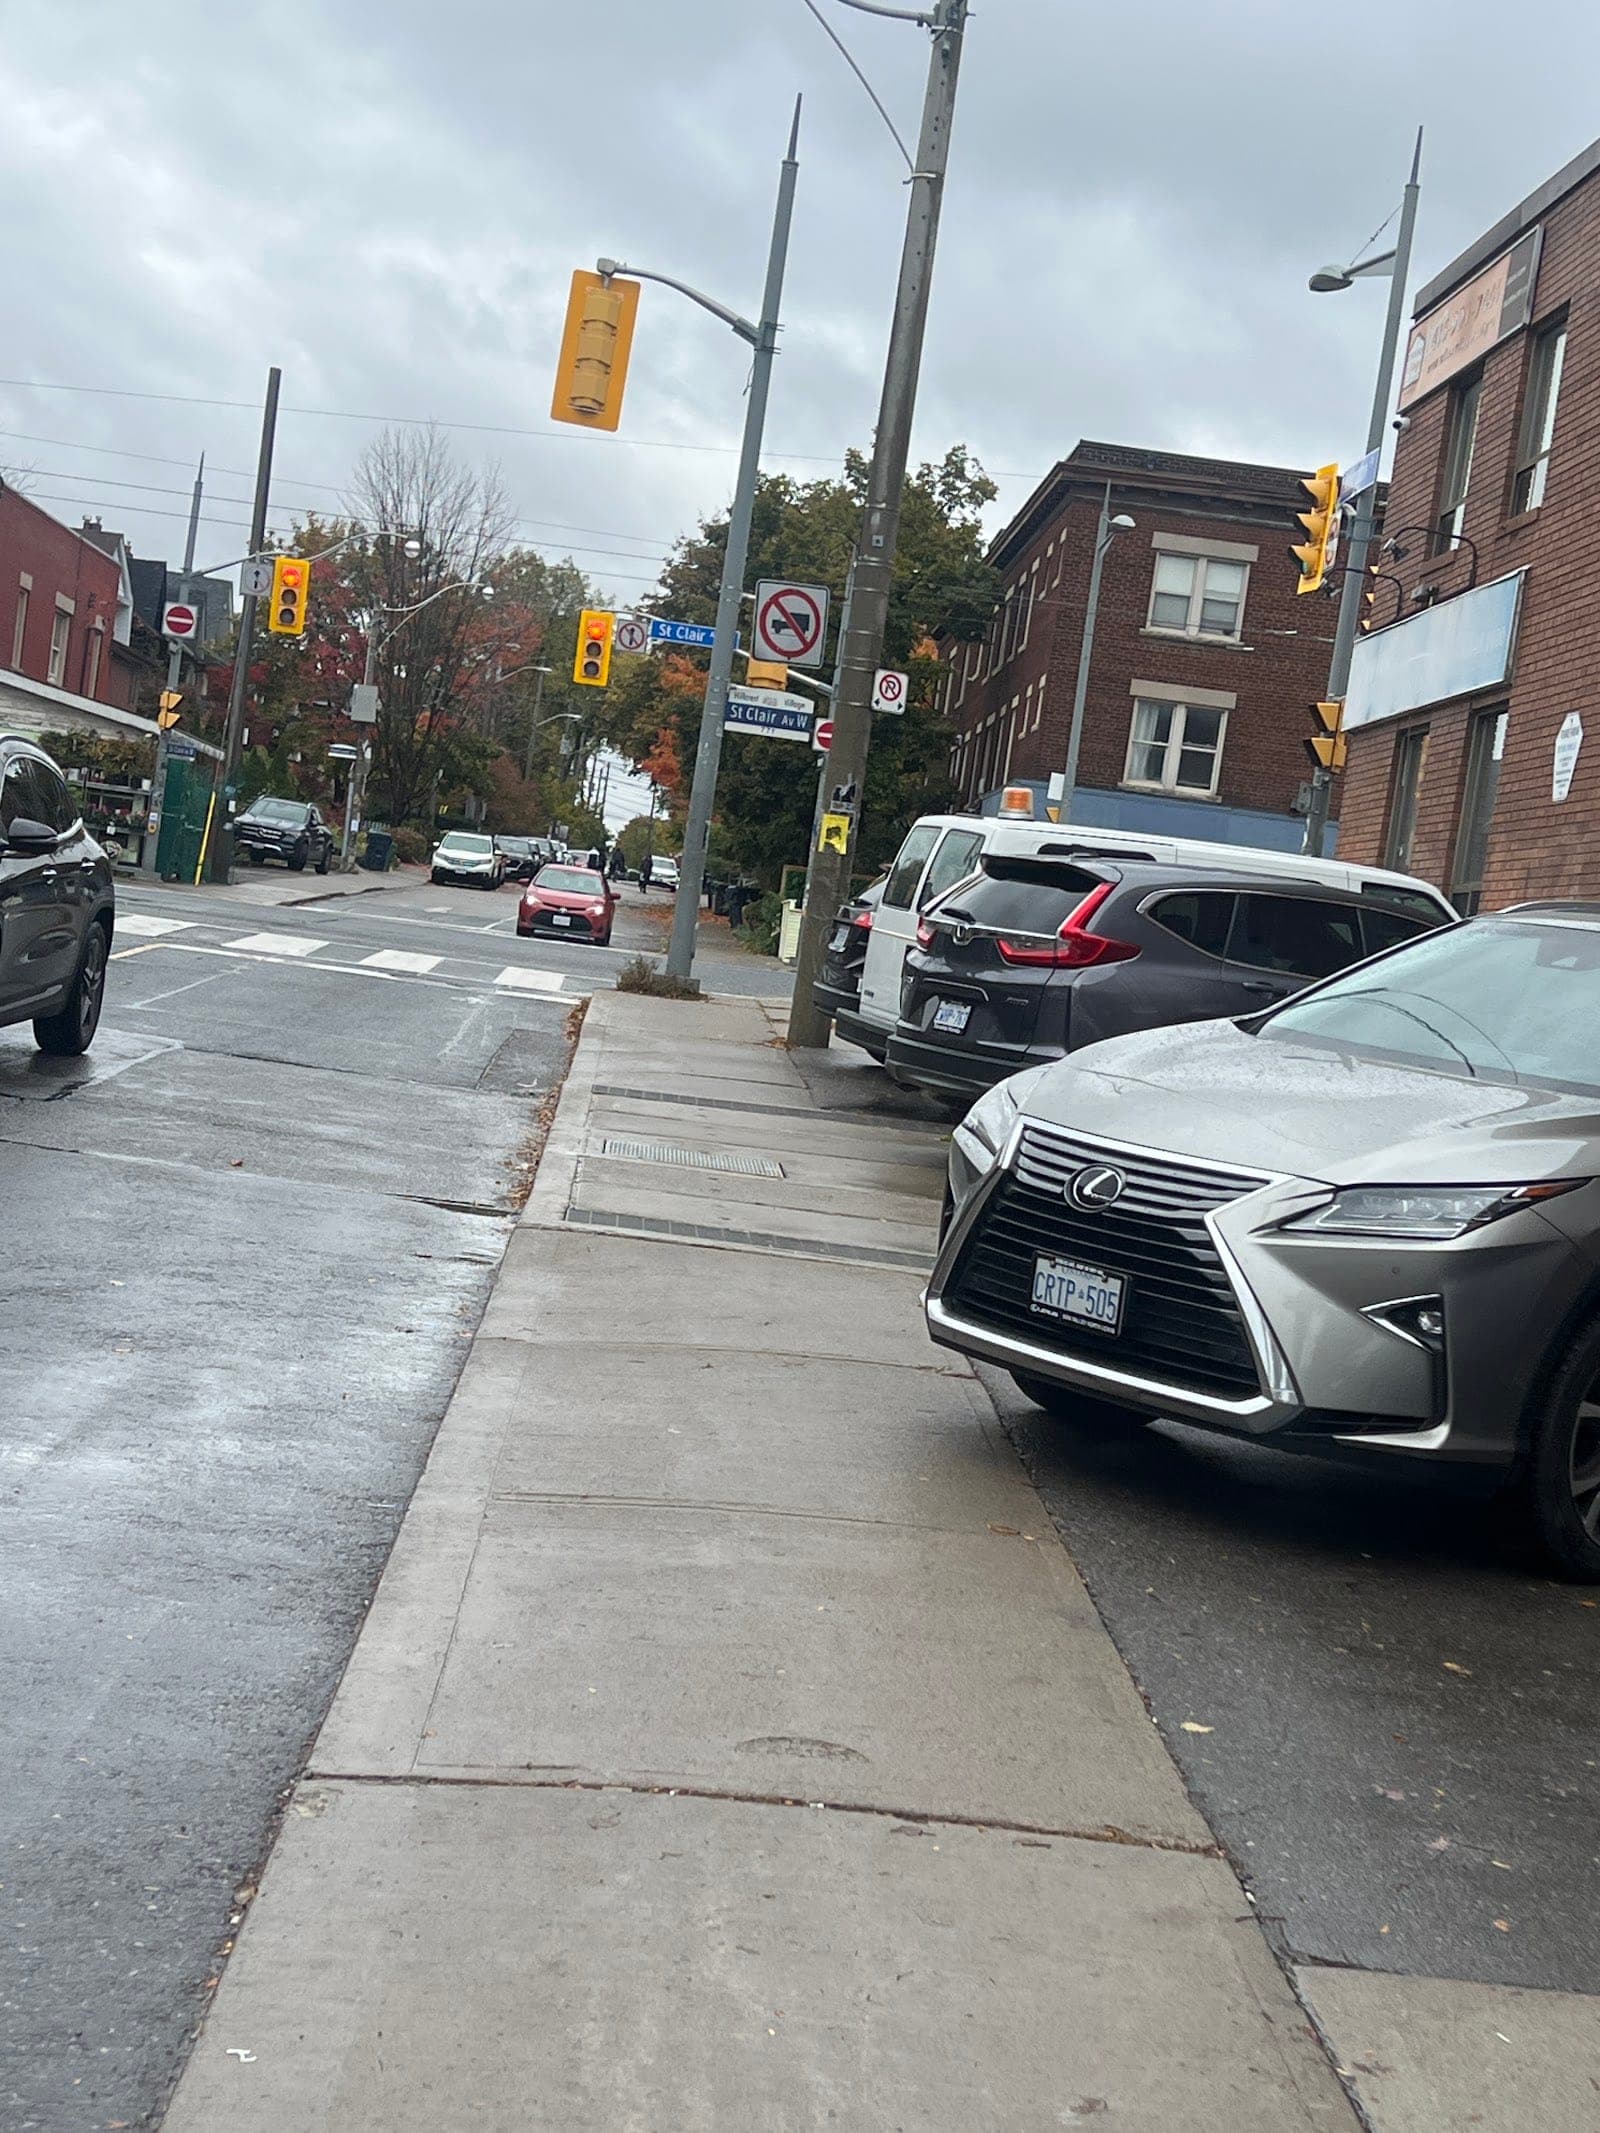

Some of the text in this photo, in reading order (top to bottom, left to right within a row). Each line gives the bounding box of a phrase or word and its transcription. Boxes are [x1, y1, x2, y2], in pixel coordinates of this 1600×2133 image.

[659, 624, 672, 638] St
[676, 626, 706, 642] Clair
[730, 705, 809, 729] St Clair Av W
[1034, 1271, 1118, 1321] CRTP 505
